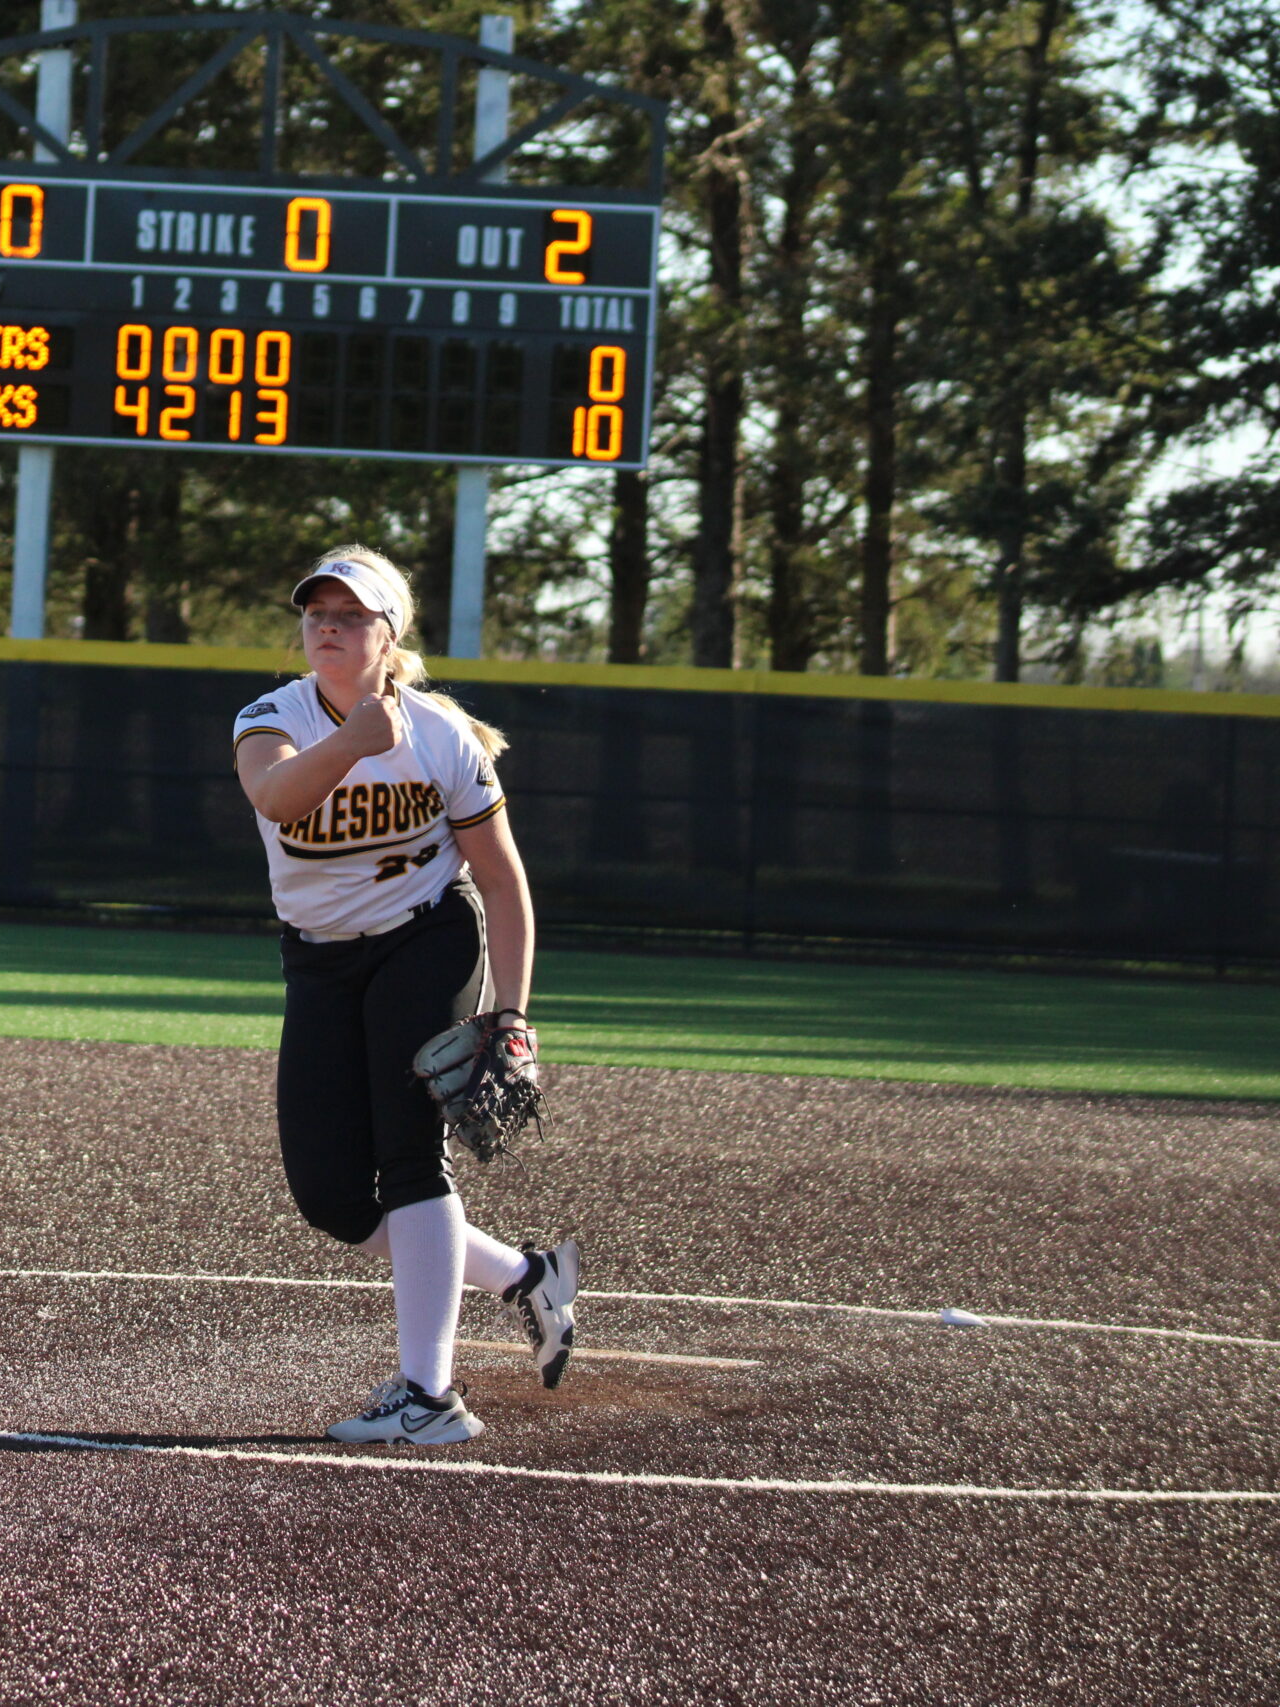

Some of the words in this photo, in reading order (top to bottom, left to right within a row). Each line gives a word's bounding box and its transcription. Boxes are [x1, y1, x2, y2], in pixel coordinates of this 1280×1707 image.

[136, 209, 256, 257] STRIKE
[285, 197, 331, 272] 0
[457, 224, 524, 269] OUT
[544, 209, 593, 285] 2
[131, 275, 144, 308] 1
[174, 277, 193, 311] 2
[220, 279, 239, 313] 3
[266, 281, 284, 315] 4
[312, 283, 331, 318] 5
[358, 285, 377, 320] 6
[406, 288, 424, 322] 7
[452, 290, 470, 324] 8
[498, 292, 517, 327] 9
[559, 295, 635, 332] TOTAL
[116, 323, 153, 381] 0
[162, 326, 198, 382] 0
[208, 328, 245, 385] 0
[255, 330, 292, 387] 0
[588, 345, 627, 403] 0
[114, 385, 150, 437] 4
[159, 384, 197, 441] 2
[229, 390, 242, 441] 1
[254, 388, 289, 446] 3
[571, 404, 625, 462] 10
